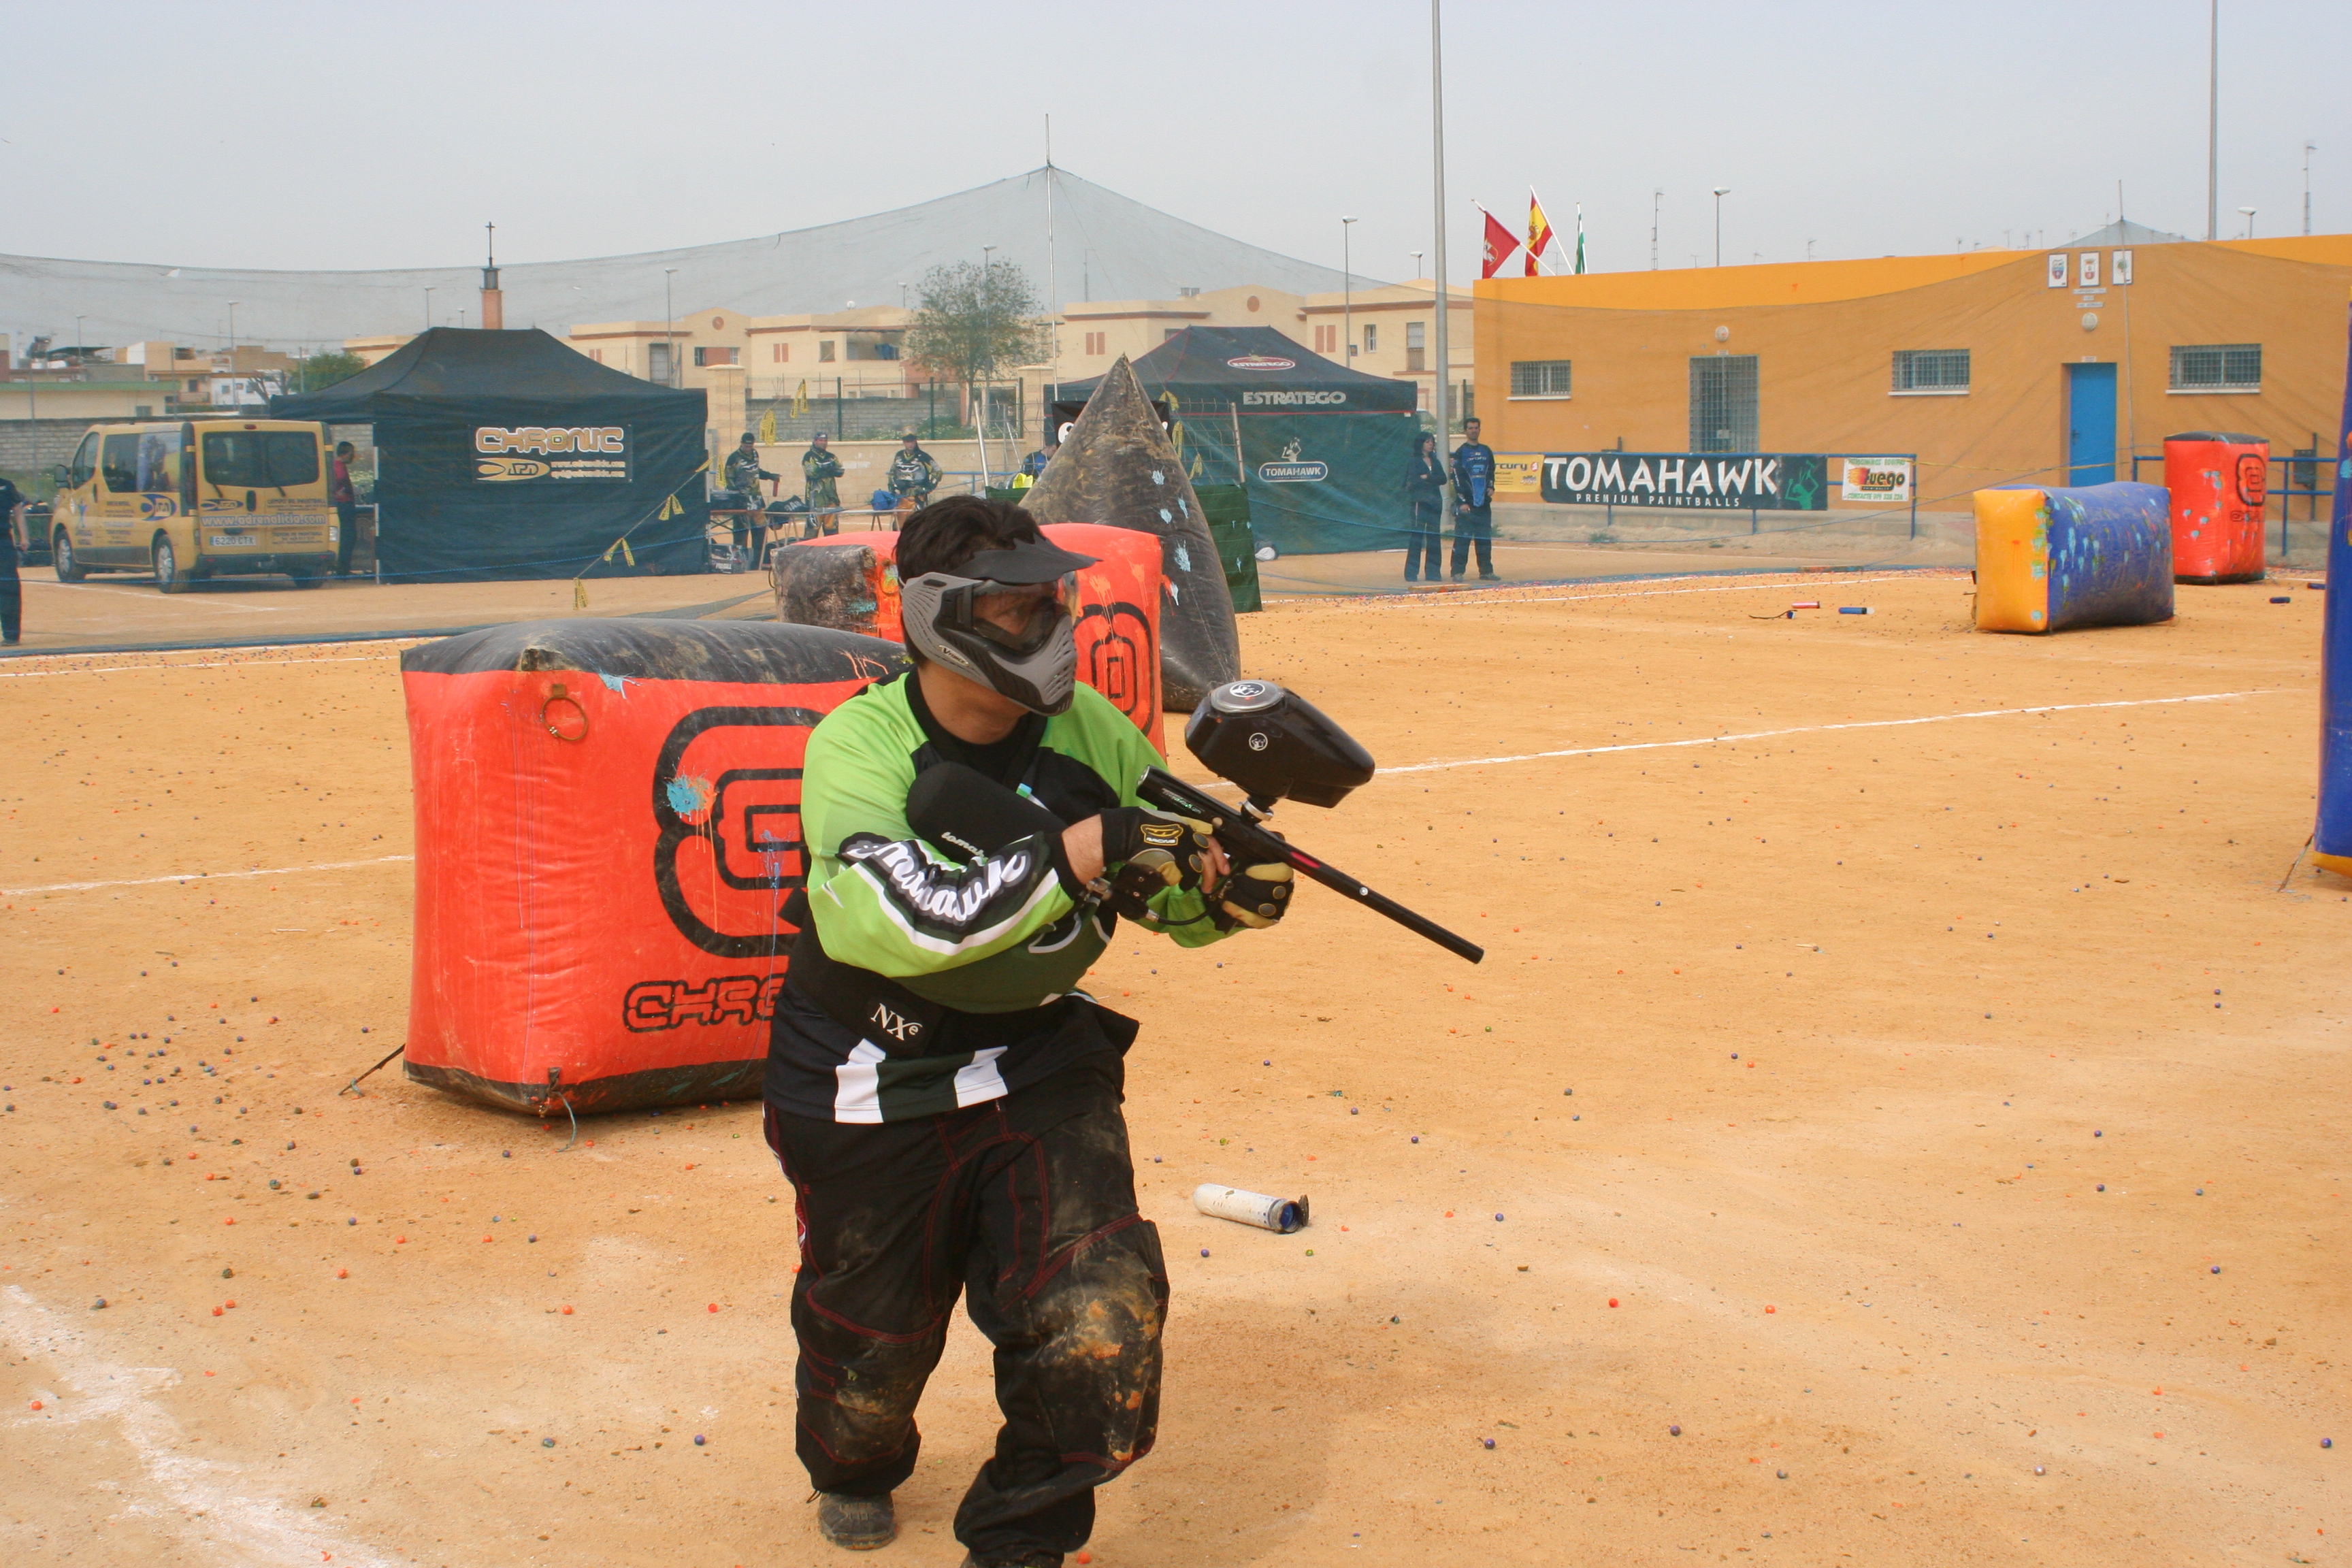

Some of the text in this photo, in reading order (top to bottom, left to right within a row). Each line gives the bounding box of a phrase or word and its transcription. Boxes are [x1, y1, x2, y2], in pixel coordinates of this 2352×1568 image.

[1243, 391, 1347, 405] ESTRATEGO
[476, 427, 624, 455] CHRONIC
[1266, 467, 1321, 476] TOMAHAWK
[1544, 457, 1778, 496] TOMAHAWK
[1576, 493, 1740, 507] PREMIUM PAINTBALLS
[201, 512, 327, 527] www.adrenalicia.com
[214, 536, 254, 545] 6220 CTX
[941, 832, 986, 859] tomah
[623, 974, 788, 1033] CHRO
